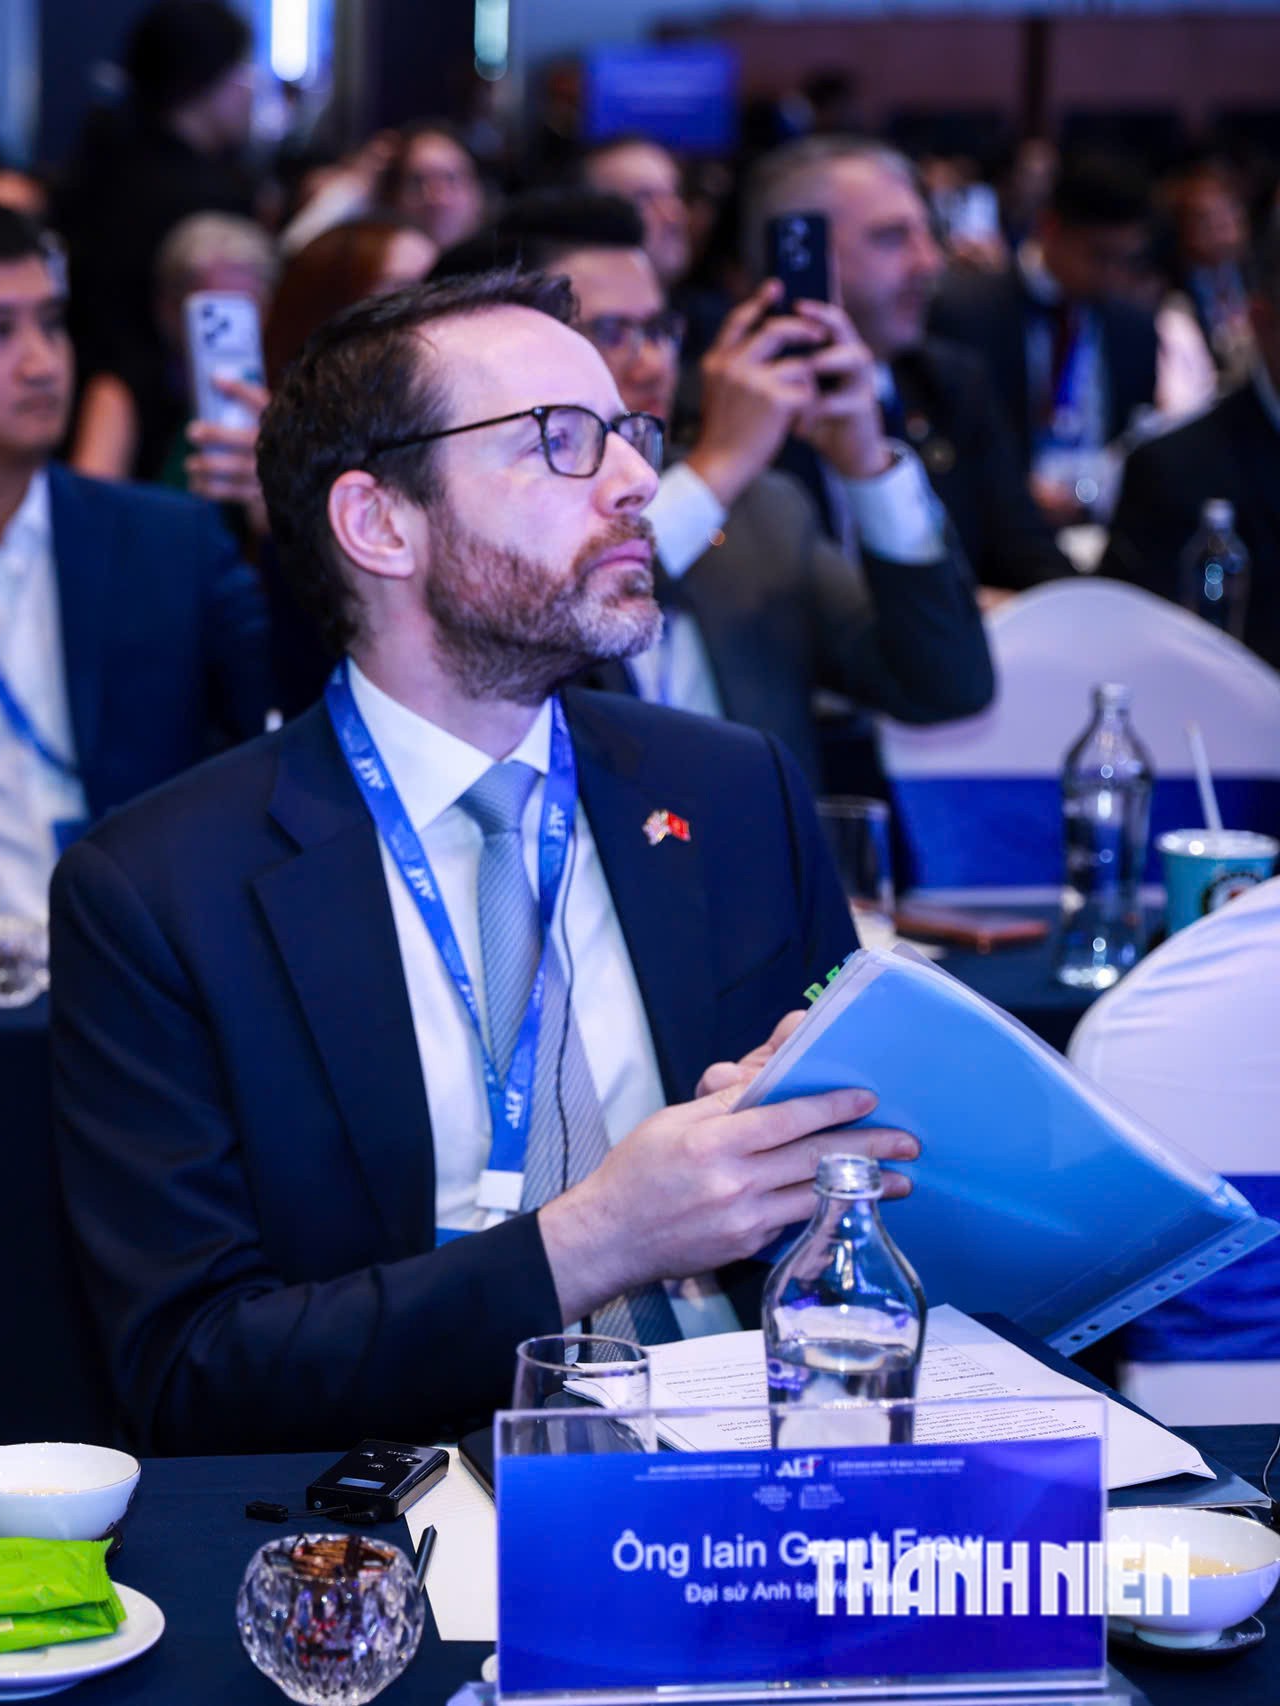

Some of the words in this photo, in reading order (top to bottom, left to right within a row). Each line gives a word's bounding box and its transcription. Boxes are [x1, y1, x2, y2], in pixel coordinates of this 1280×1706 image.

[612, 1528, 691, 1578] Ông
[702, 1532, 768, 1569] Iain
[684, 1582, 719, 1606] Đại
[752, 1580, 791, 1601] Anh
